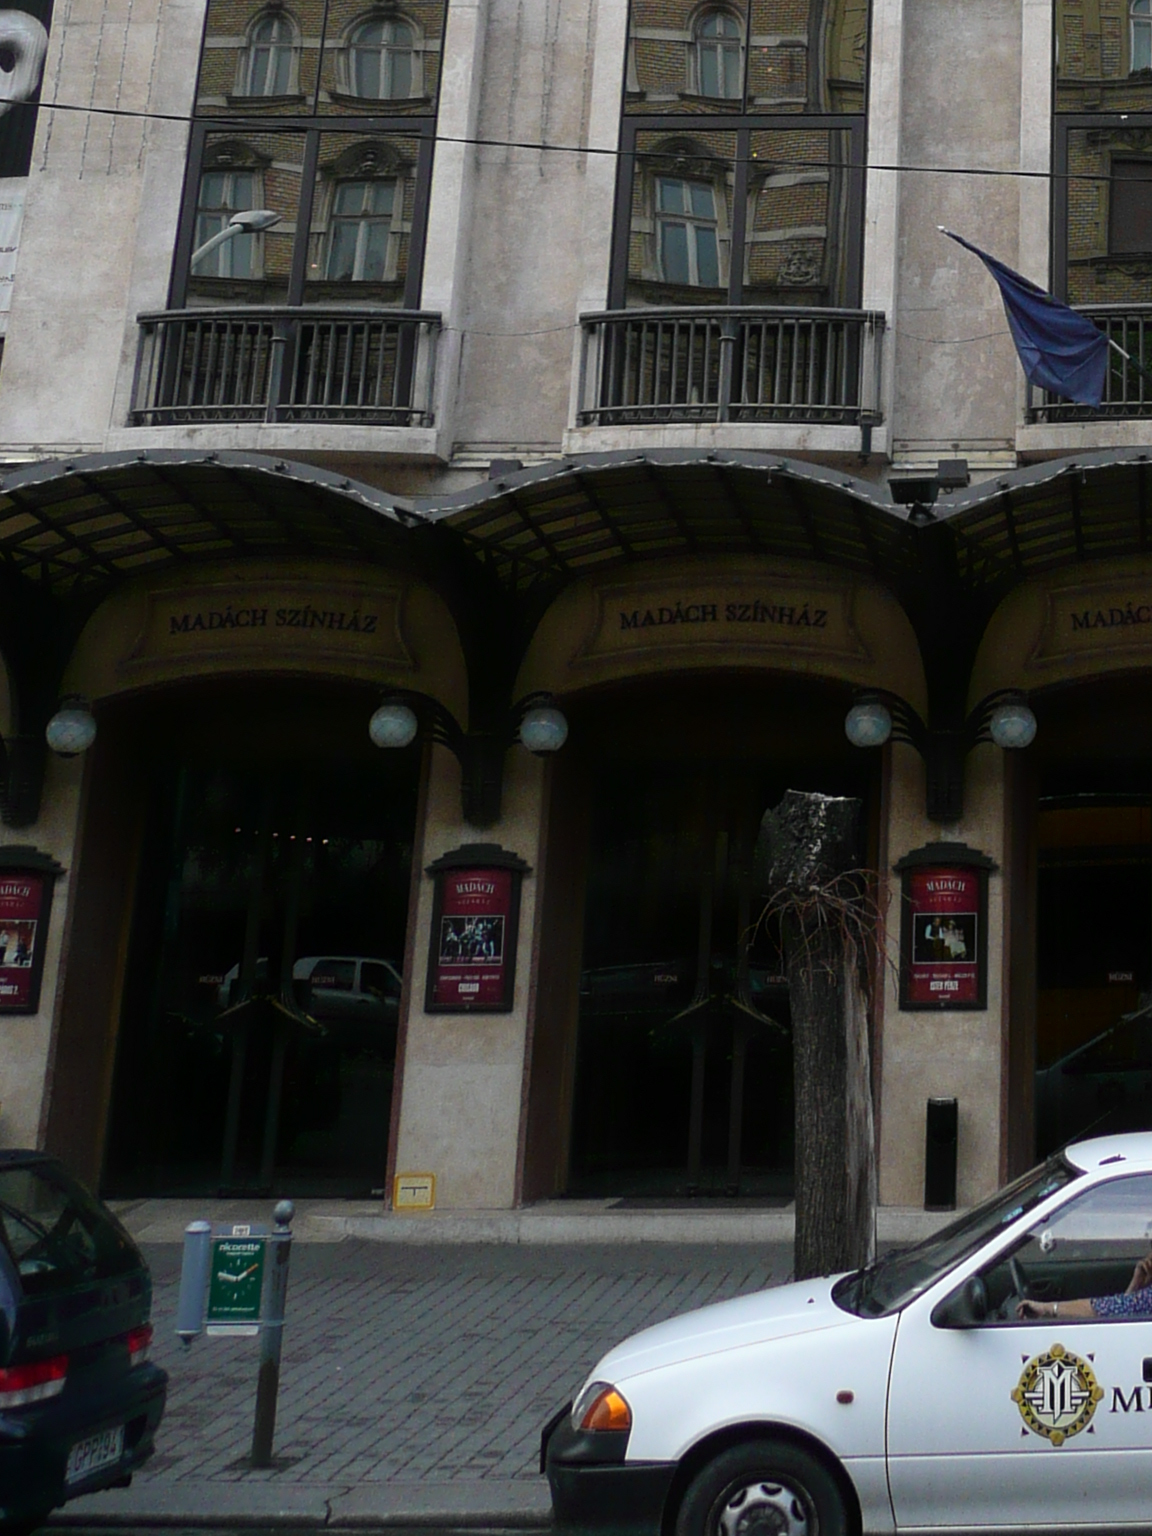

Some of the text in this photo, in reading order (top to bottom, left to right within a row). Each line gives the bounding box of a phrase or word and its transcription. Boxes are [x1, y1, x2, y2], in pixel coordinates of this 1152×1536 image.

[169, 600, 378, 634] MADÁCH SZÍNHÁZ
[620, 597, 828, 629] MADÁCH SZÍNHÁZ
[218, 1241, 261, 1253] nicorette
